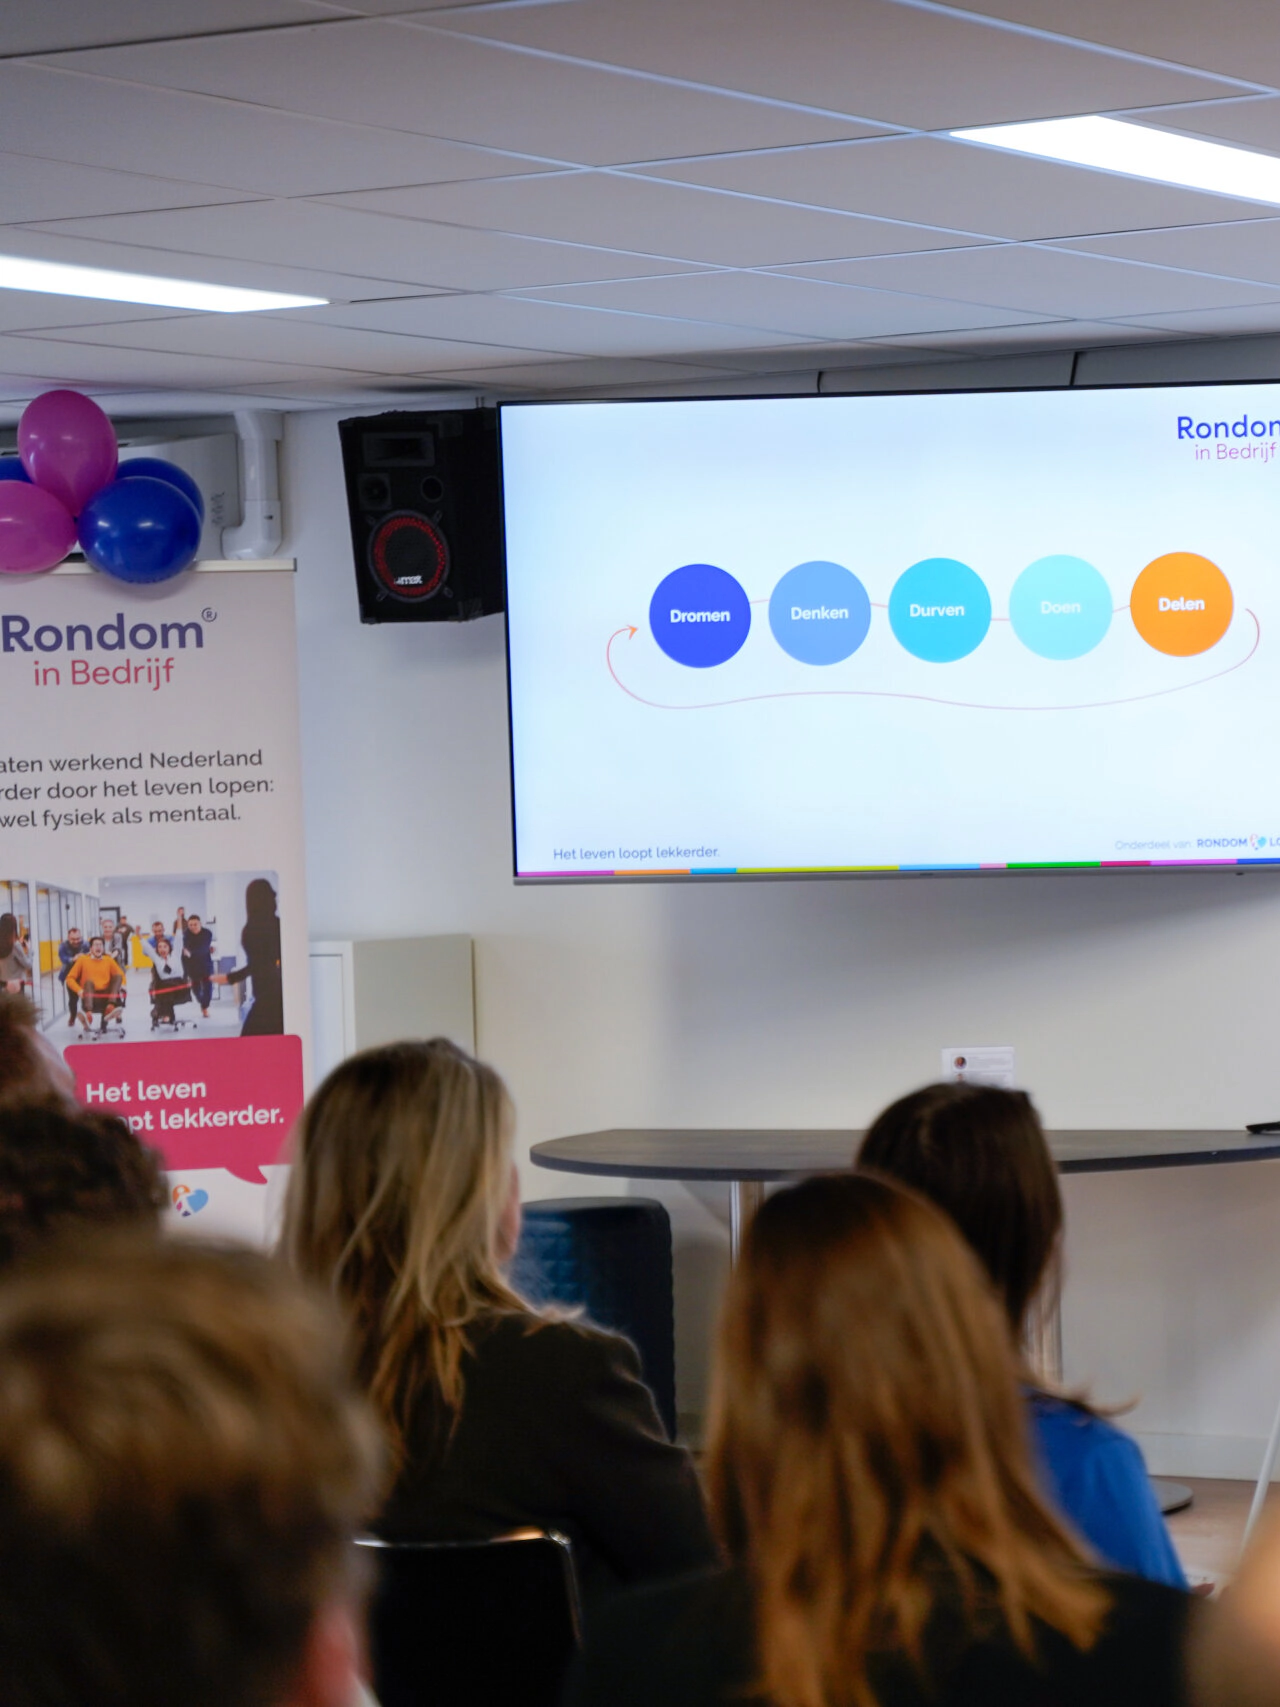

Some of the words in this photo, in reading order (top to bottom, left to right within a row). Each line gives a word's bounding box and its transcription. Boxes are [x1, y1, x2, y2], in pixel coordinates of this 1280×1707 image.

[1195, 444, 1210, 460] in
[1216, 441, 1277, 463] Bedrijf
[791, 605, 849, 620] Denken
[909, 602, 965, 617] Durven
[1040, 600, 1082, 614] Doen
[1158, 597, 1206, 612] Delen
[670, 608, 731, 623] Dromen
[33, 660, 60, 686] in
[71, 657, 175, 691] Bedrijf
[49, 752, 143, 772] werkend
[150, 749, 263, 769] Nederland
[47, 781, 98, 799] door
[103, 780, 138, 798] het
[144, 779, 202, 797] leven
[209, 777, 275, 797] lopen:
[43, 808, 106, 831] fysiek
[112, 806, 142, 825] als
[149, 803, 241, 823] mentaal.
[1197, 837, 1248, 848] RONDOM
[553, 848, 577, 860] Het
[580, 848, 615, 860] leven
[619, 847, 652, 861] loopt
[656, 846, 721, 858] lekkerder.
[86, 1081, 131, 1103] Het
[137, 1080, 207, 1101] leven
[160, 1104, 285, 1130] lekkerder.
